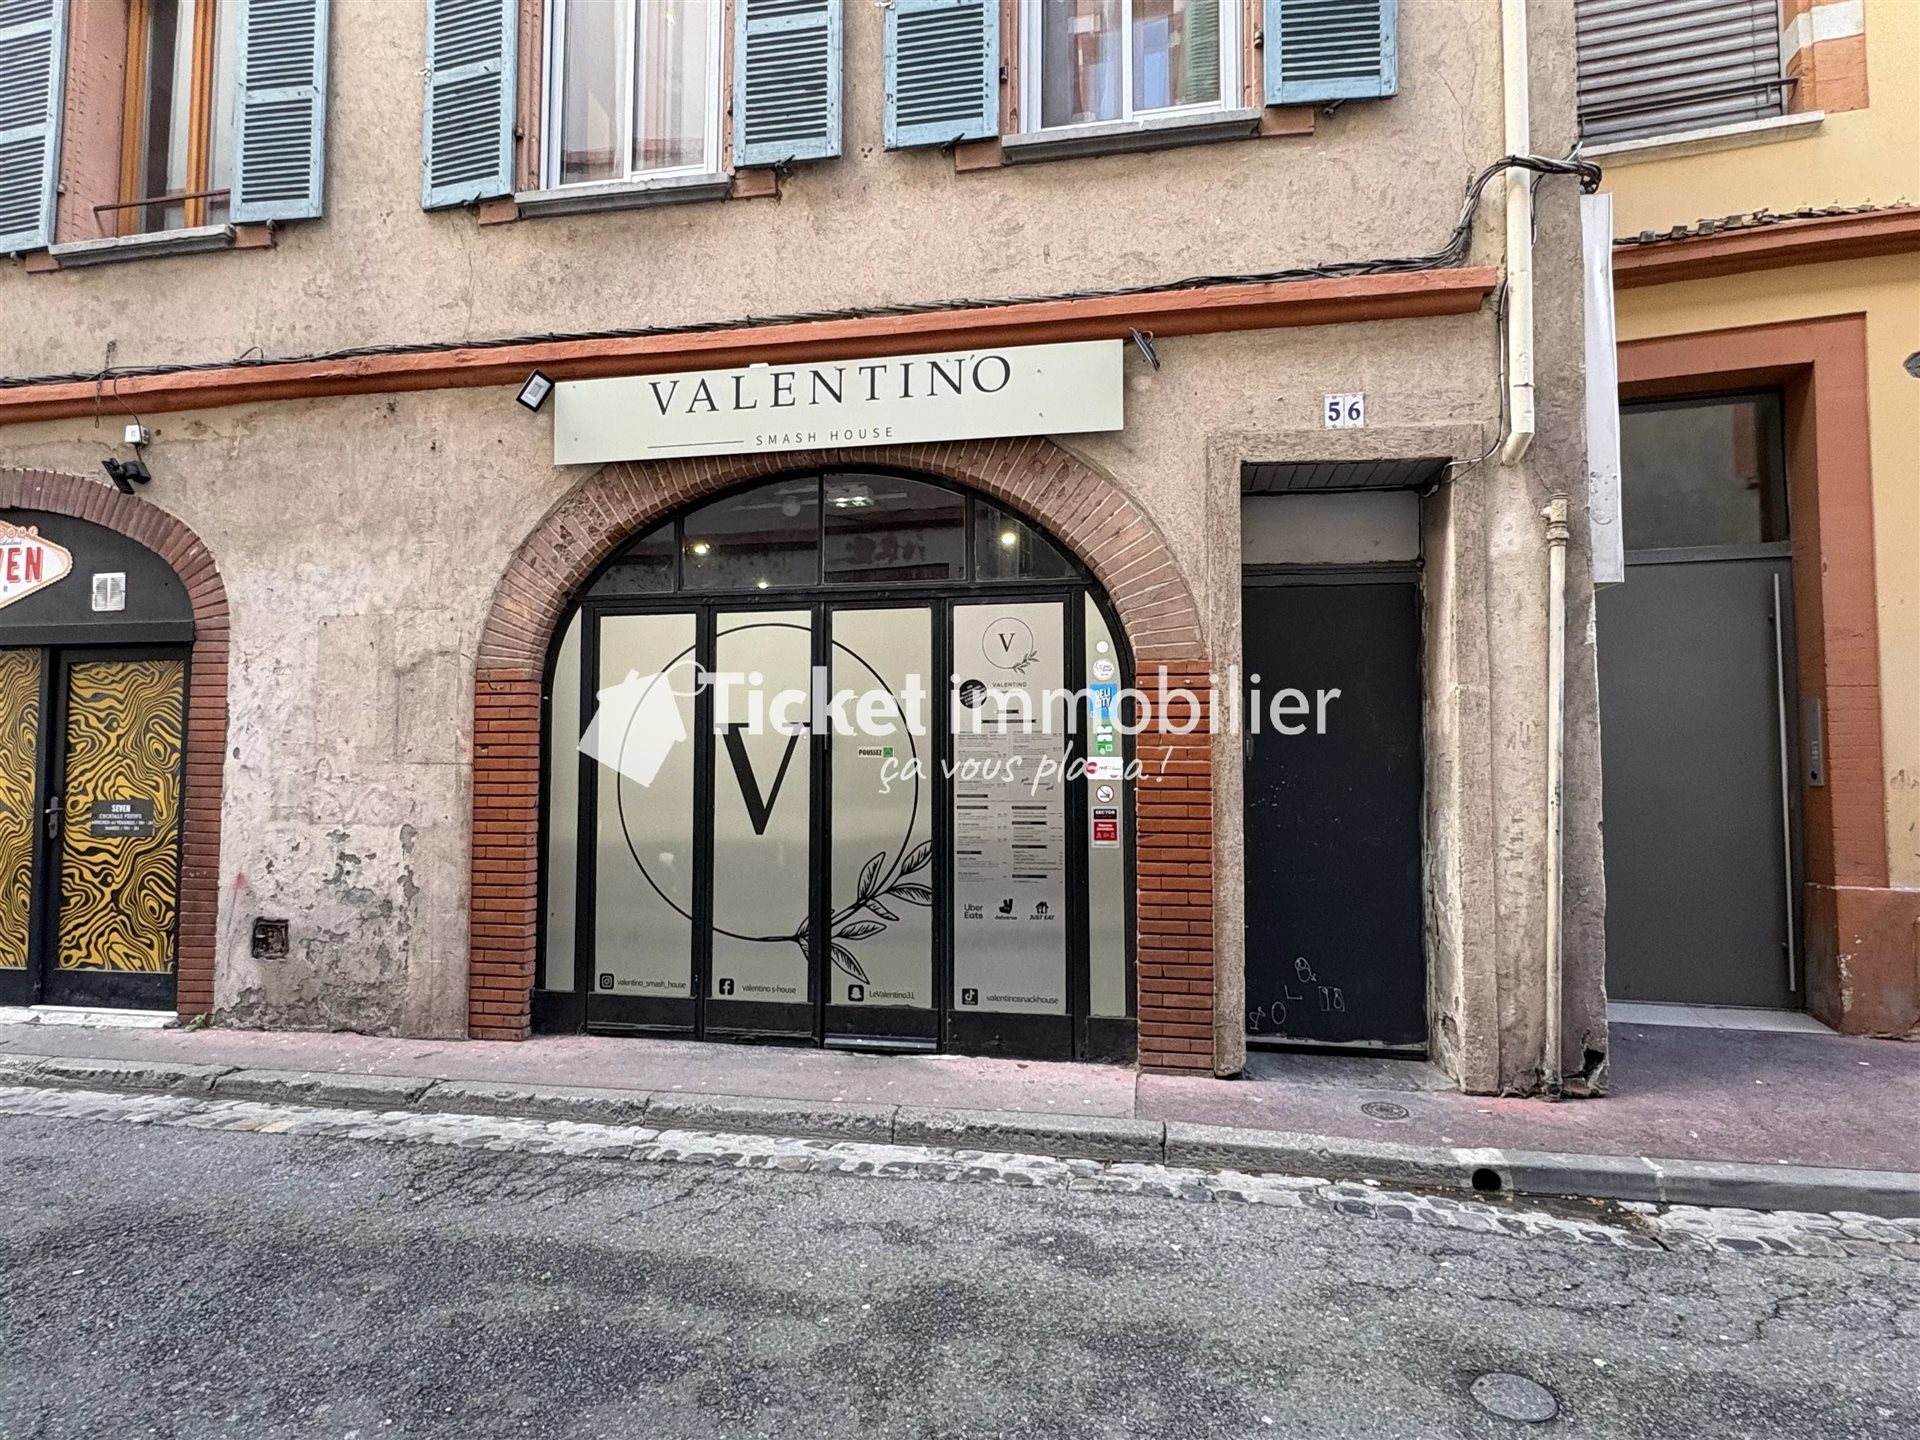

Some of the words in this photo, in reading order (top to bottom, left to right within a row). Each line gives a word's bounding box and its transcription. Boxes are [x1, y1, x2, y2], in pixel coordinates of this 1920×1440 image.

[1328, 400, 1361, 421] 56
[756, 431, 817, 446] SMASH
[830, 426, 894, 441] HOUSE
[0, 546, 43, 584] EN
[996, 632, 1016, 652] V
[858, 748, 882, 756] POUSSEZ
[713, 721, 811, 836] V
[111, 804, 131, 813] SEVEN
[964, 903, 983, 911] Uber
[964, 912, 983, 920] Eats
